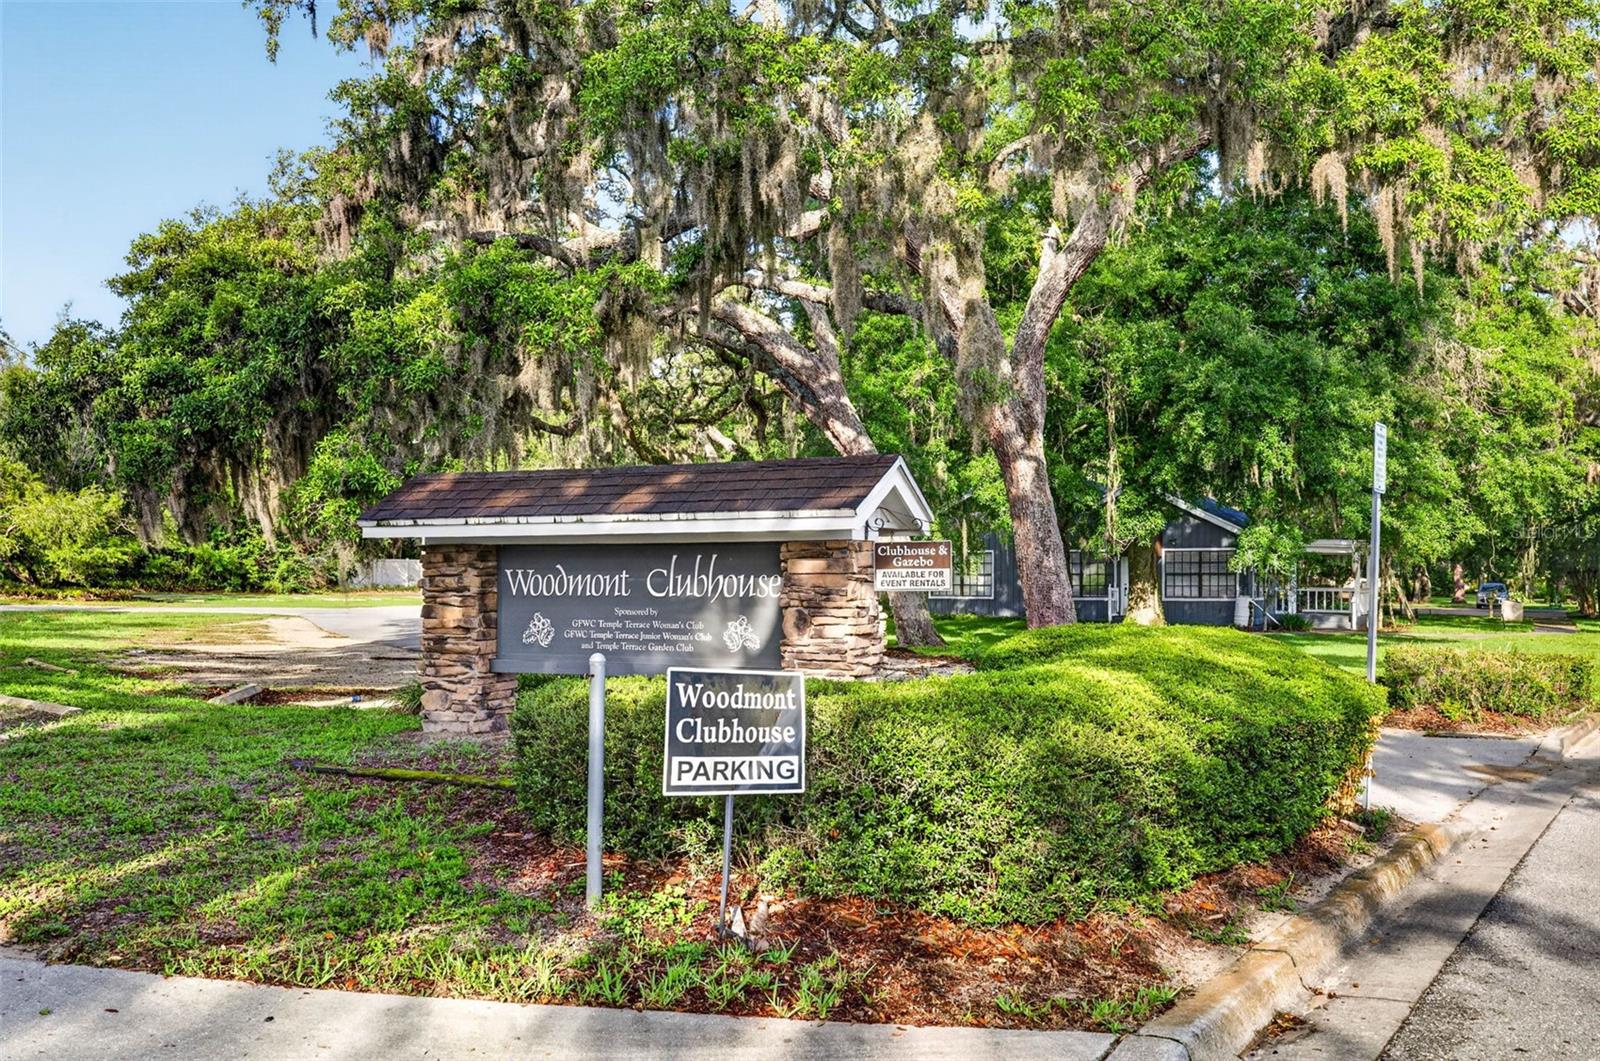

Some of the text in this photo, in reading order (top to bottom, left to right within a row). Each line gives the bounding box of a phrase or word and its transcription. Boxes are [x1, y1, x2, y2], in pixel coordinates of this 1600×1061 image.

[877, 545, 948, 556] Clubhouse &
[892, 556, 934, 567] Gazebo
[505, 554, 782, 603] Woodmont Clubhouse
[614, 607, 658, 617] Sponsored by
[572, 620, 705, 630] GFWC Temple Terrace Woman's Club
[564, 630, 713, 641] GFWC Temple Terrace Junior Woman's Club
[581, 641, 694, 652] and Temple Terrace Garden Club
[675, 682, 797, 710] Woodmont
[675, 717, 796, 743] Clubhouse
[677, 760, 795, 781] PARKING
